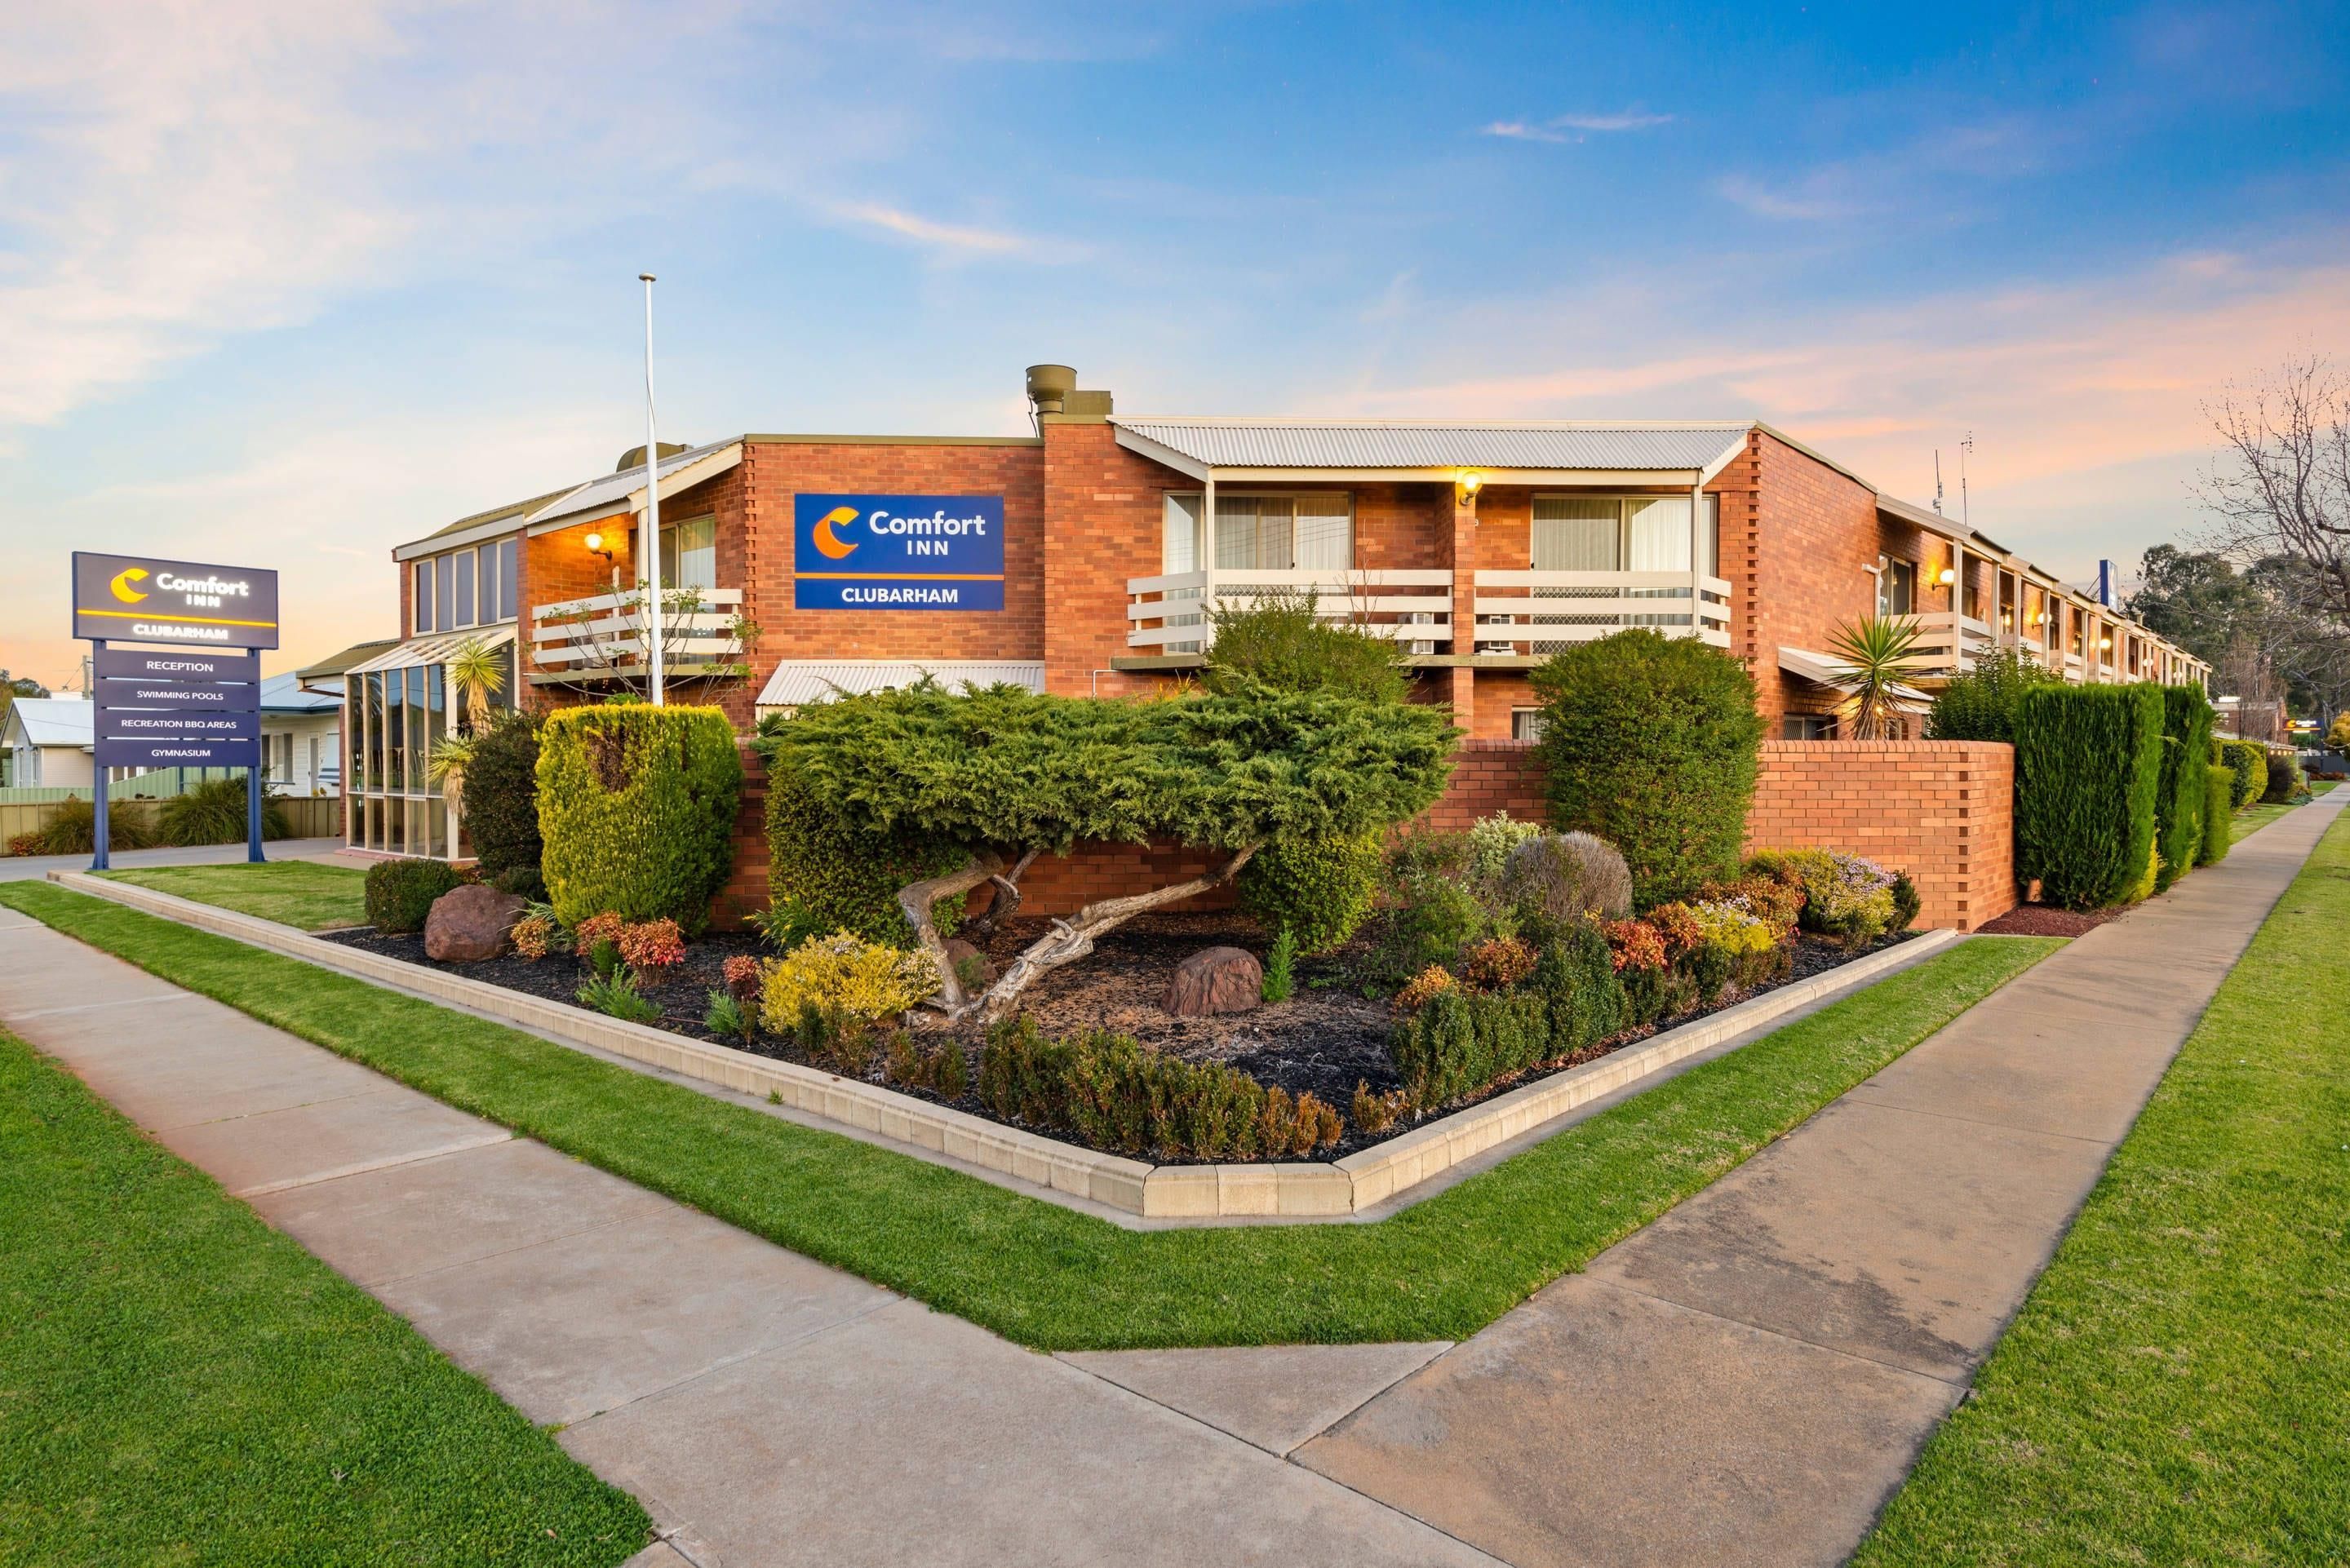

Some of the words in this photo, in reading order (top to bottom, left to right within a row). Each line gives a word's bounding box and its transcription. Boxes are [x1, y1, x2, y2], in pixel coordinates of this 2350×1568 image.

[869, 511, 986, 535] Comfort
[907, 540, 948, 556] INN
[156, 573, 249, 596] Comfort
[186, 595, 220, 607] INN
[841, 587, 958, 603] CLUBARHAM
[132, 623, 228, 640] CLUBARHAM
[146, 660, 214, 672] RECEPTION
[136, 690, 190, 700] SWIMMING
[192, 692, 224, 701] POOLS
[121, 719, 183, 729] RECREATION
[184, 720, 206, 729] BBQ
[151, 749, 211, 757] GYMNASIUM
